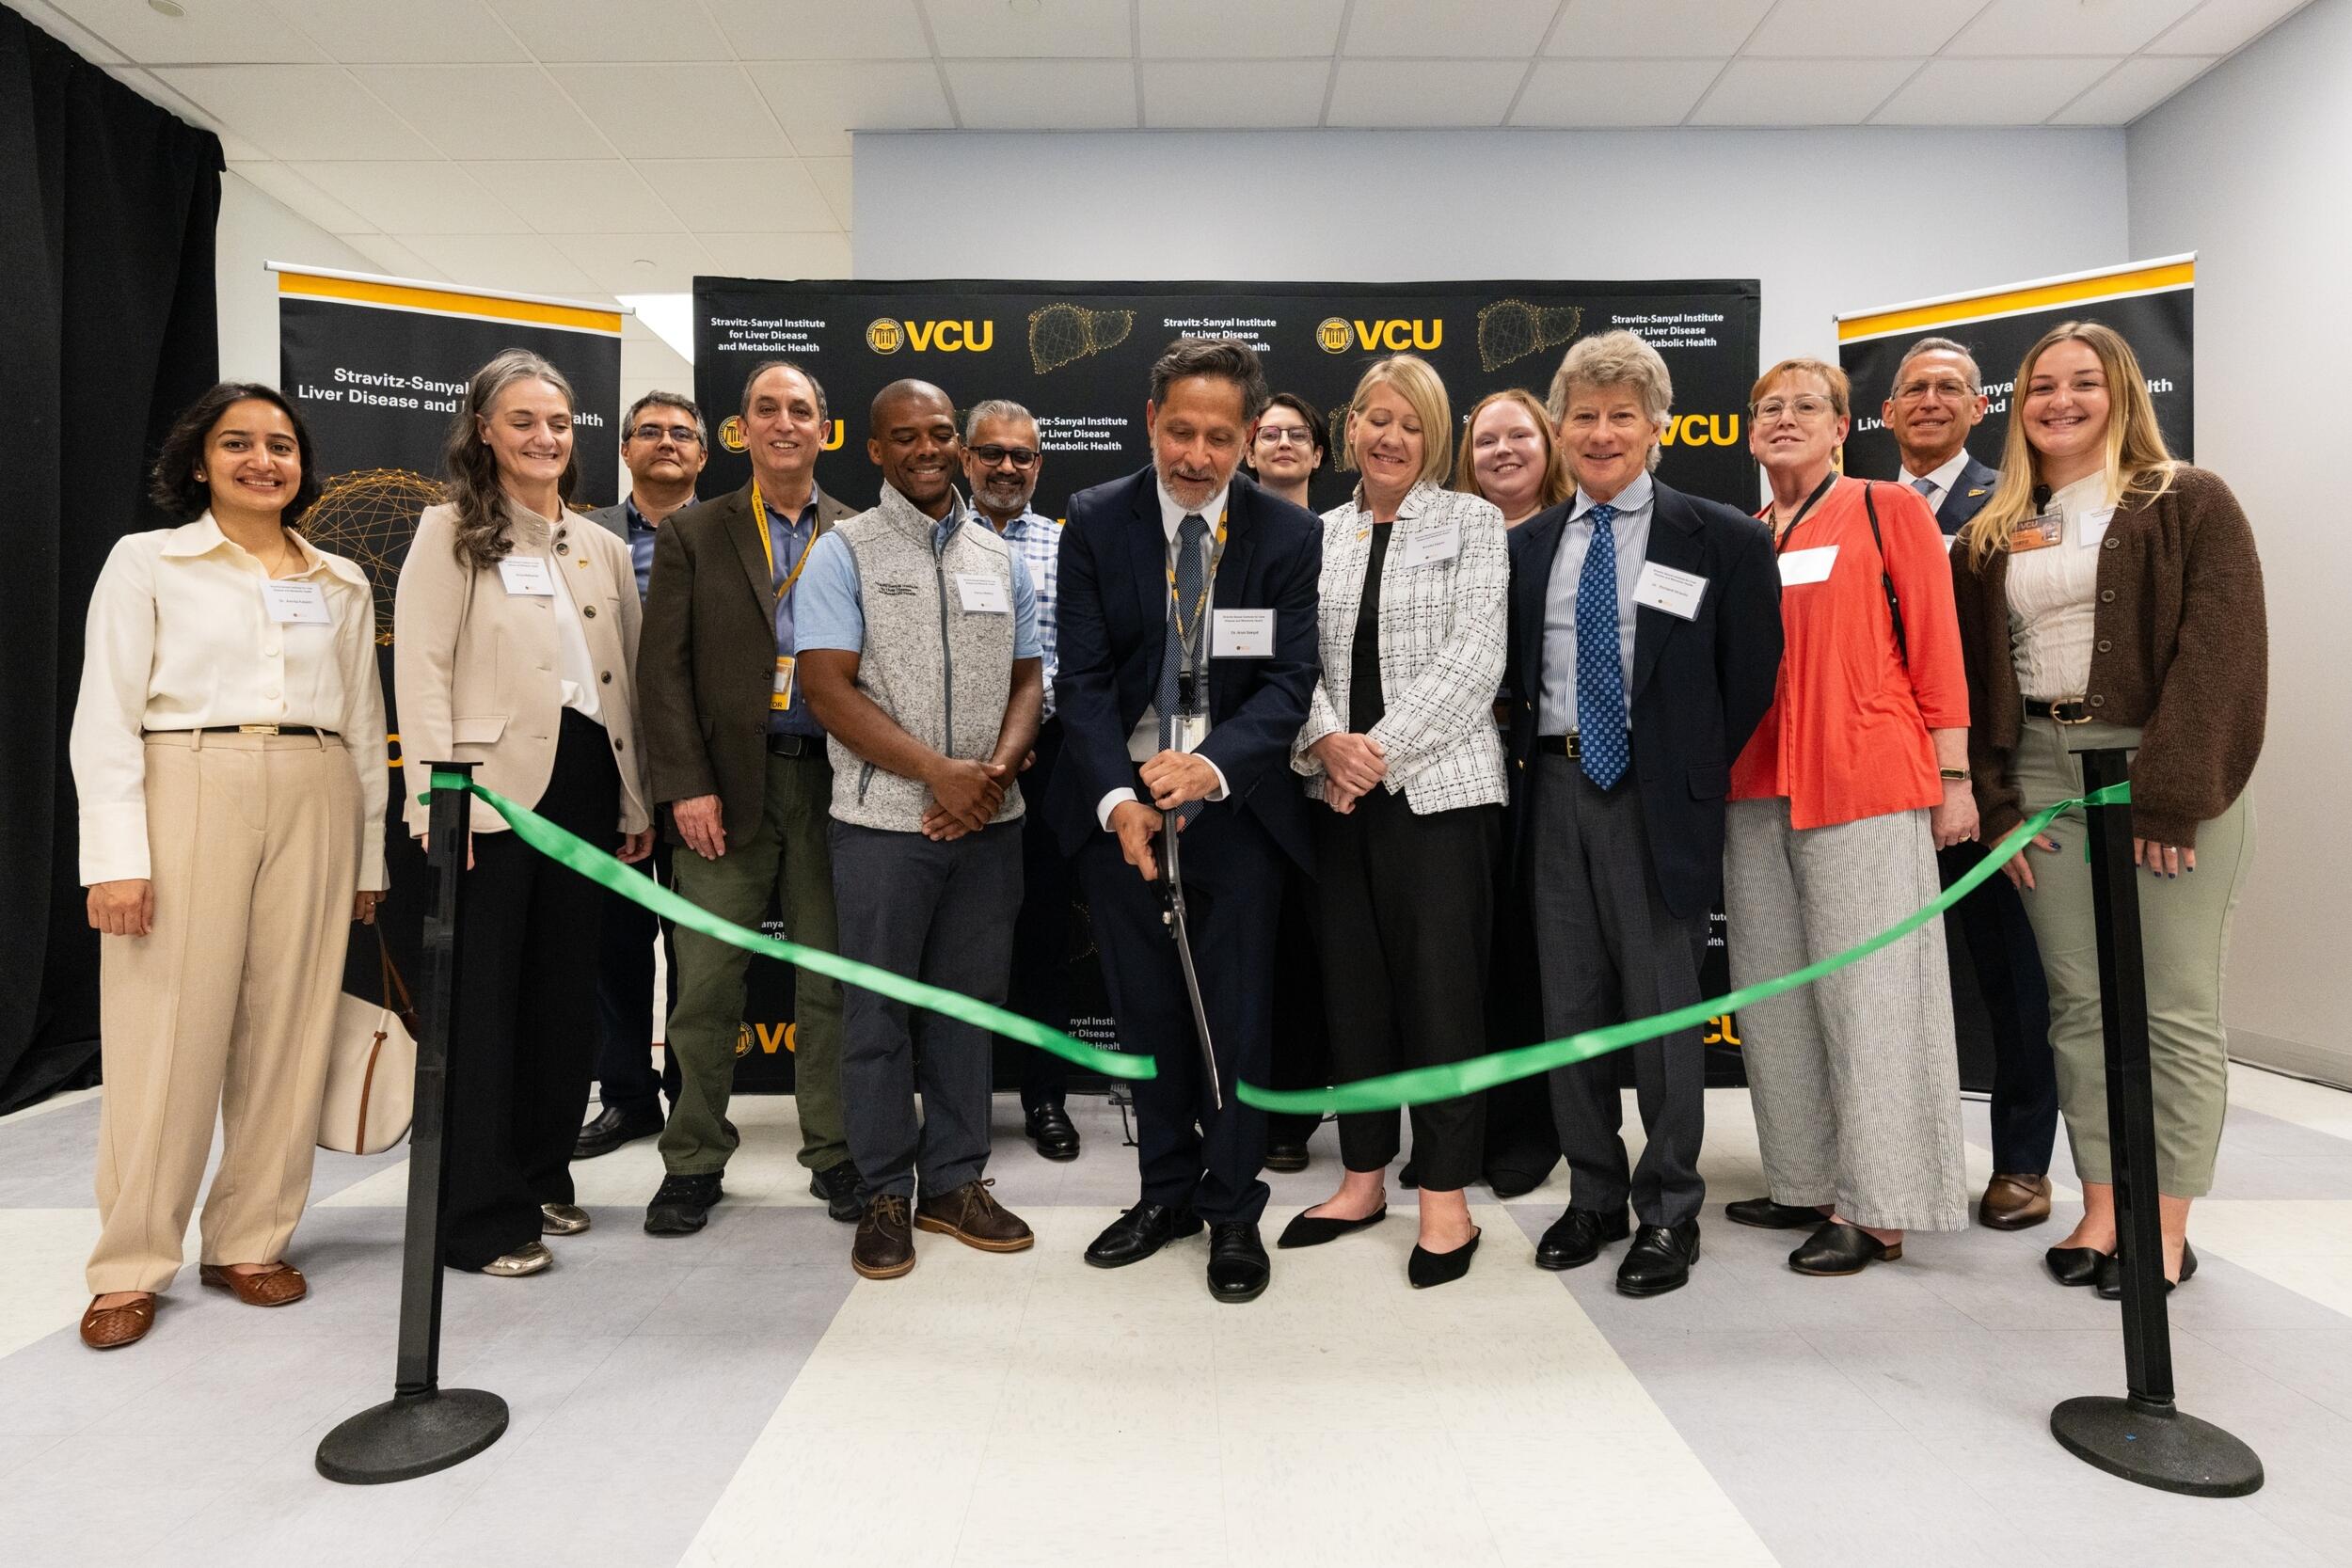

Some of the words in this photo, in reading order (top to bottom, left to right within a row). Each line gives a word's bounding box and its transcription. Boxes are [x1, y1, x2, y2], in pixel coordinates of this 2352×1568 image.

[710, 317, 783, 329] Stravitz-Sanyal
[785, 318, 826, 328] Institute
[1163, 317, 1235, 328] Stravitz-Sanyal
[1236, 318, 1277, 327] Institute
[1612, 313, 1682, 325] Stravitz-Sanyal
[1684, 313, 1724, 323] Institute
[729, 330, 743, 339] for
[745, 330, 770, 340] Liver
[771, 330, 808, 340] Disease
[904, 320, 993, 352] VCU
[1182, 330, 1196, 339] for
[1197, 330, 1221, 339] Liver
[1222, 330, 1260, 340] Disease
[1354, 319, 1443, 351] VCU
[1629, 326, 1643, 336] for
[1645, 326, 1669, 336] Liver
[1670, 325, 1707, 335] Disease
[718, 341, 737, 352] and
[738, 342, 787, 352] Metabolic
[787, 342, 820, 353] Health
[1686, 338, 1717, 347] Health
[334, 367, 469, 395] Stravitz-Sanyal
[298, 384, 343, 402] Liver
[348, 388, 419, 408] Disease
[424, 399, 457, 414] and
[573, 412, 603, 428] alth
[1984, 399, 2007, 414] nd
[1088, 417, 1128, 426] Institute
[1048, 429, 1073, 438] Liver
[1073, 430, 1110, 438] Disease
[1660, 414, 1739, 446] VCU
[1041, 441, 1089, 451] Metabolic
[1090, 441, 1122, 451] Health
[1078, 1028, 1115, 1038] Disease
[1095, 1040, 1120, 1051] Healt
